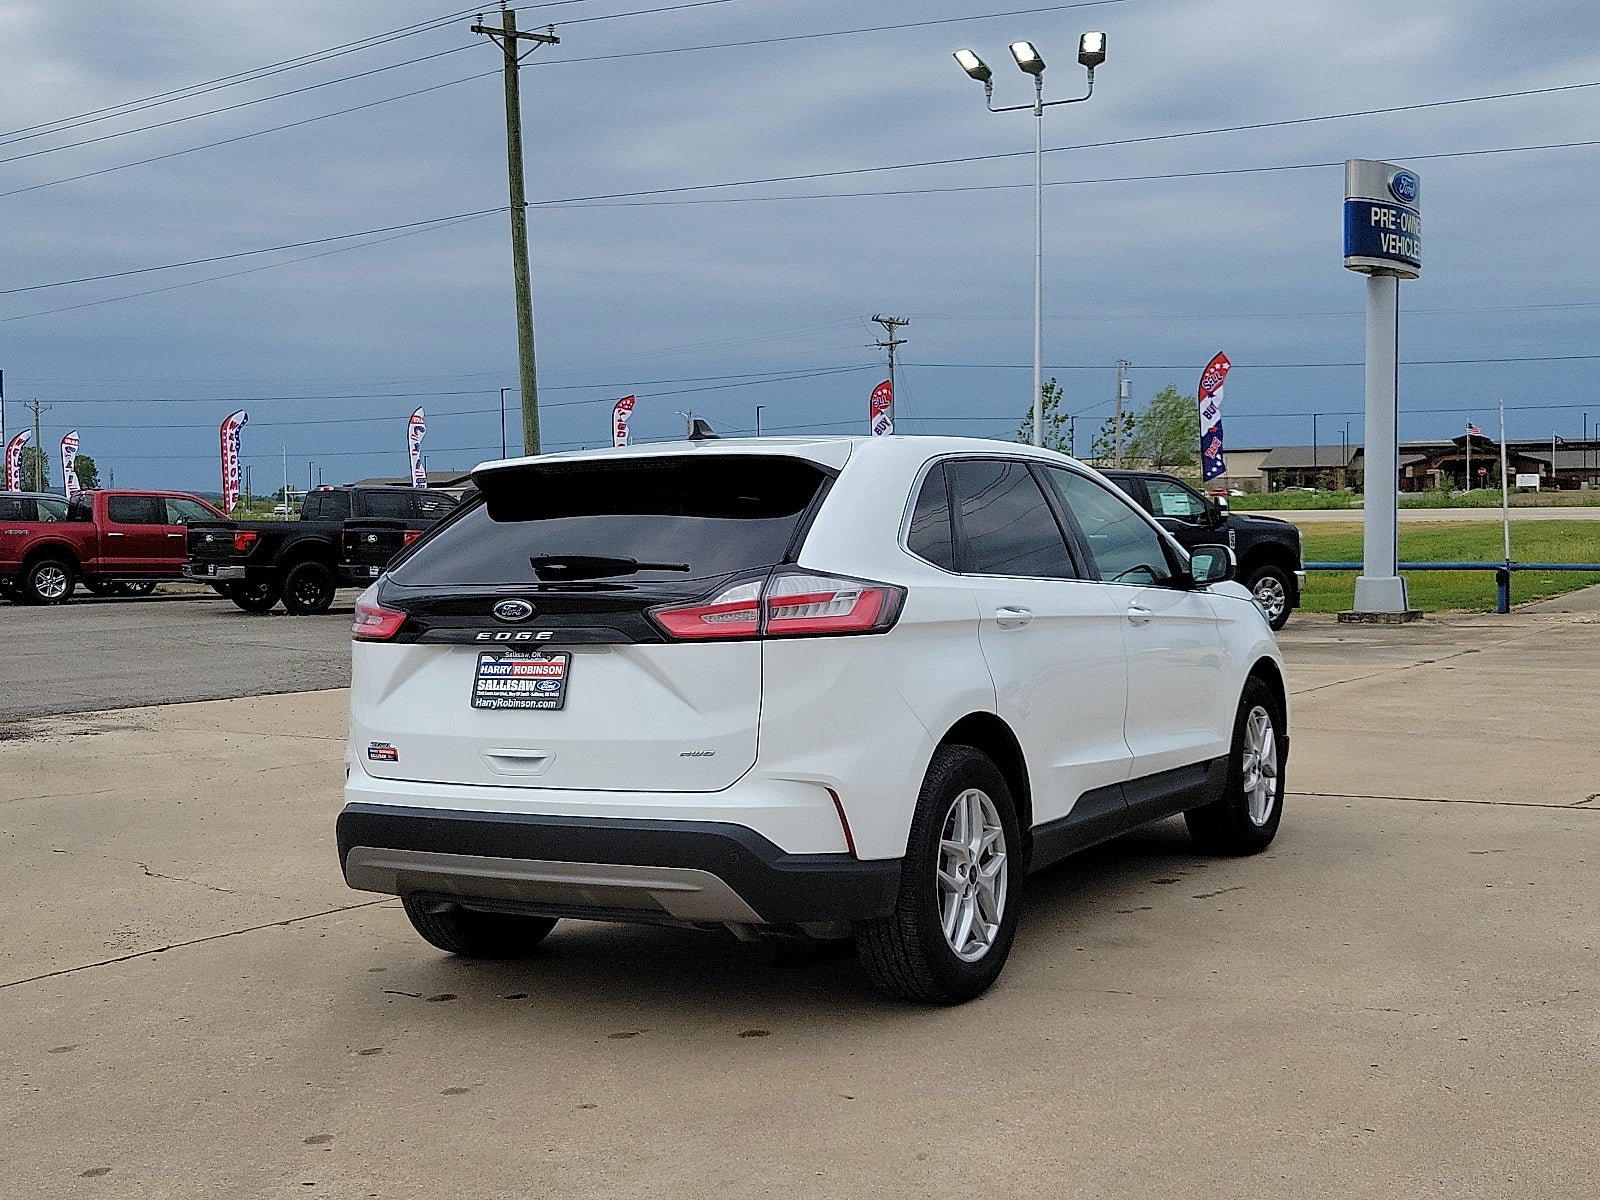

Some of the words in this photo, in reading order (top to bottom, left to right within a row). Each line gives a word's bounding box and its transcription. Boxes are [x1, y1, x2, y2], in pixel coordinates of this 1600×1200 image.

[1371, 207, 1420, 236] PRE-OWNE
[1380, 232, 1420, 260] VEHICLE
[874, 416, 891, 436] BUY
[228, 420, 240, 503] WELCOME
[501, 604, 522, 616] Ford
[476, 631, 554, 641] EDGE
[504, 651, 531, 659] Sallisaw,
[480, 665, 512, 675] HARRY
[513, 665, 563, 675] ROBINSON
[477, 680, 536, 692] SALLISAW
[475, 697, 557, 709] HarryRobinson.com
